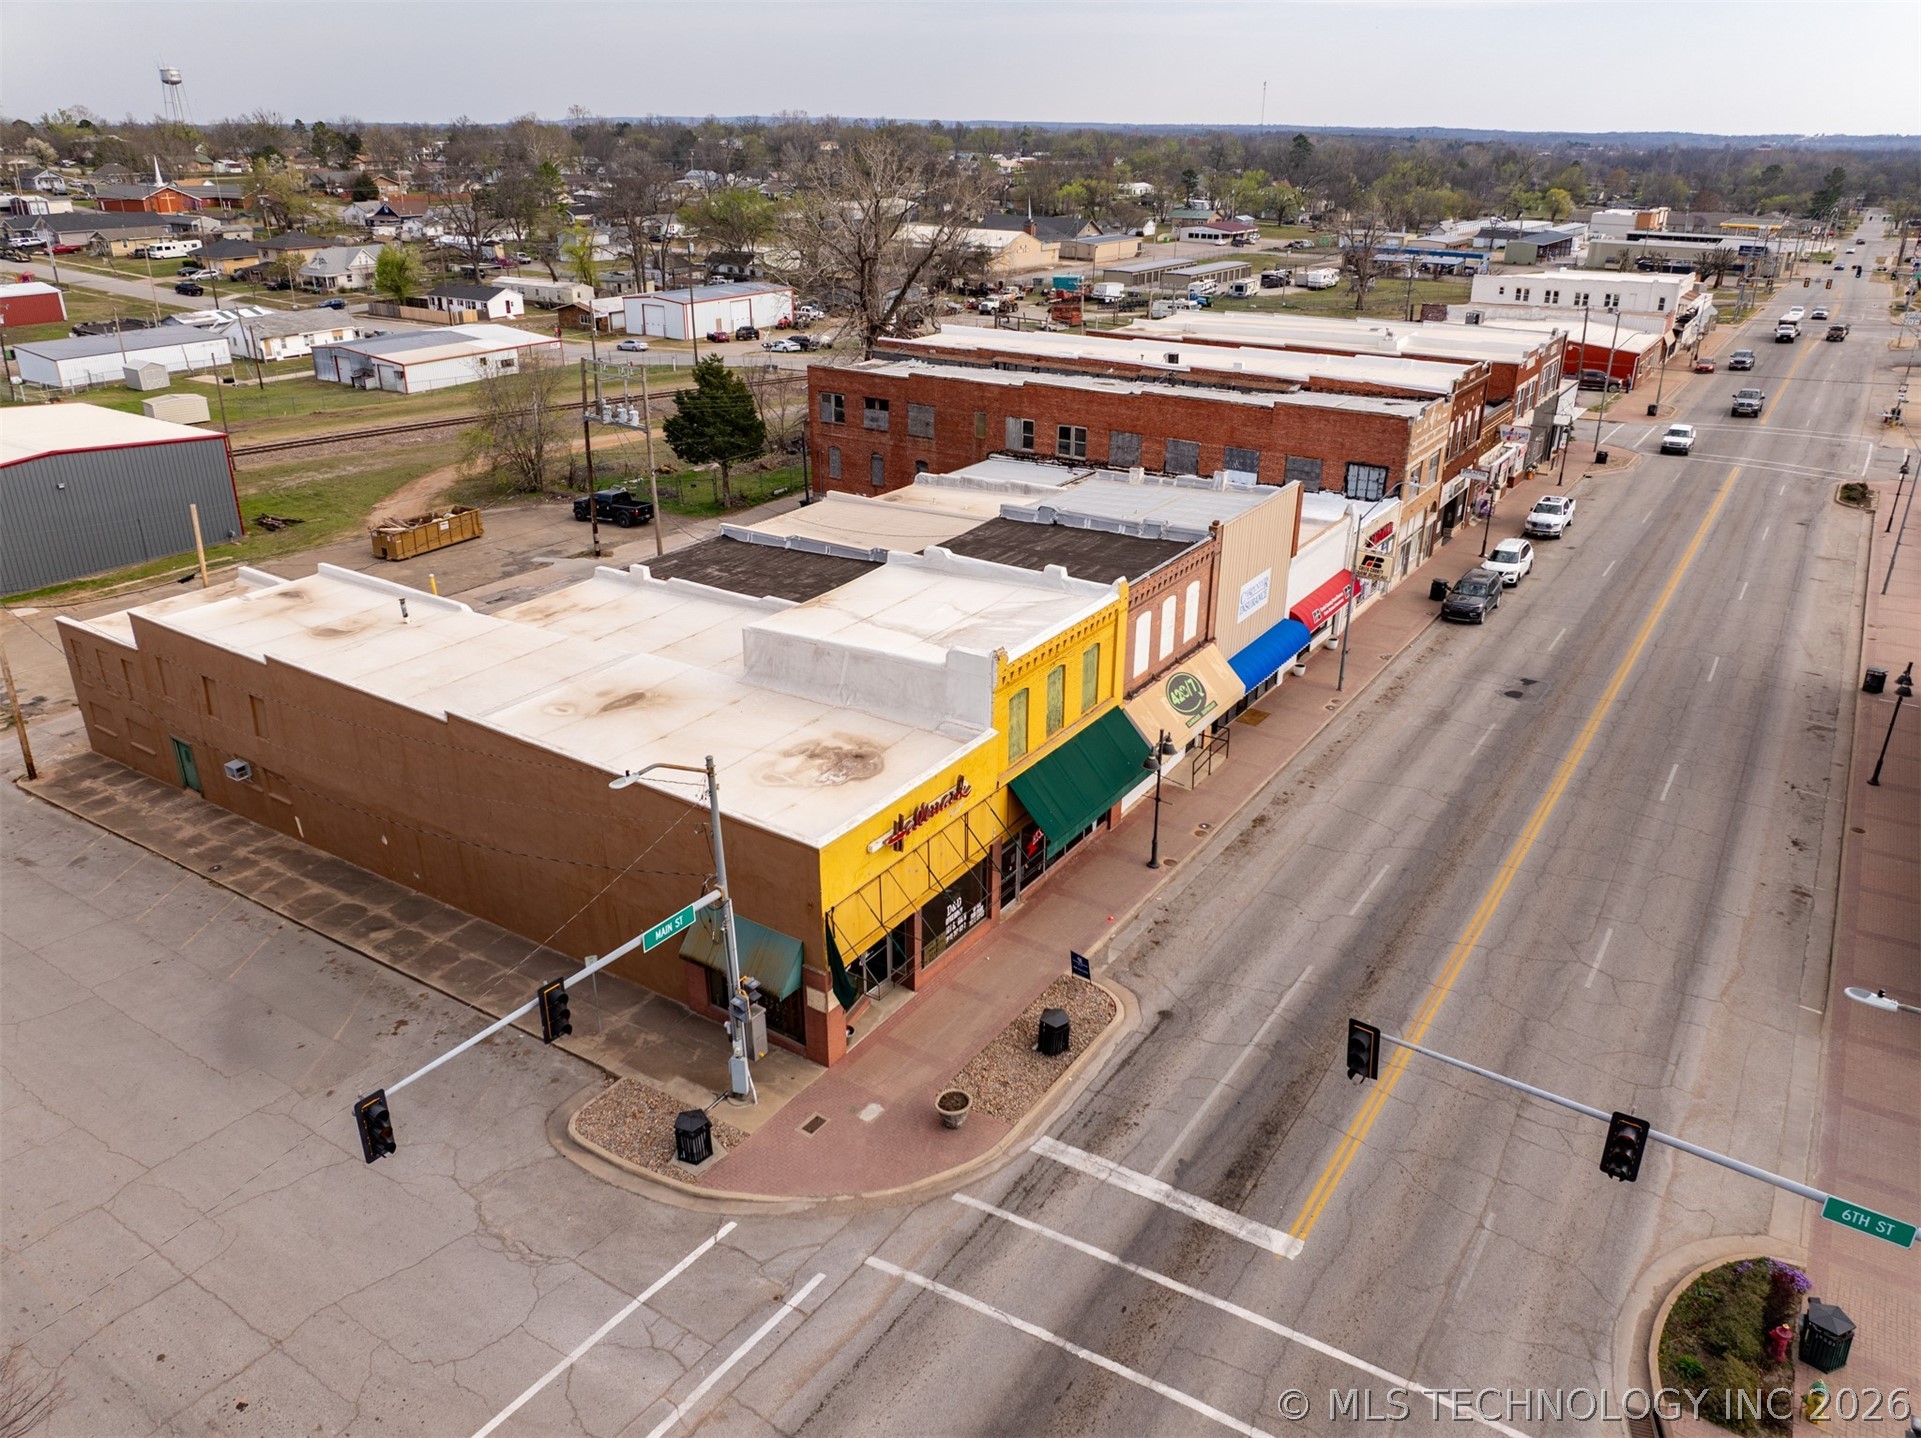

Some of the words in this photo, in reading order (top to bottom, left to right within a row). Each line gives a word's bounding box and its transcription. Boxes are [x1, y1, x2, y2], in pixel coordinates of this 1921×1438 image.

[882, 774, 972, 852] Hallmark
[655, 922, 673, 941] MAIN
[674, 915, 684, 928] ST
[1841, 1209, 1871, 1228] 6TH
[1875, 1220, 1896, 1236] ST
